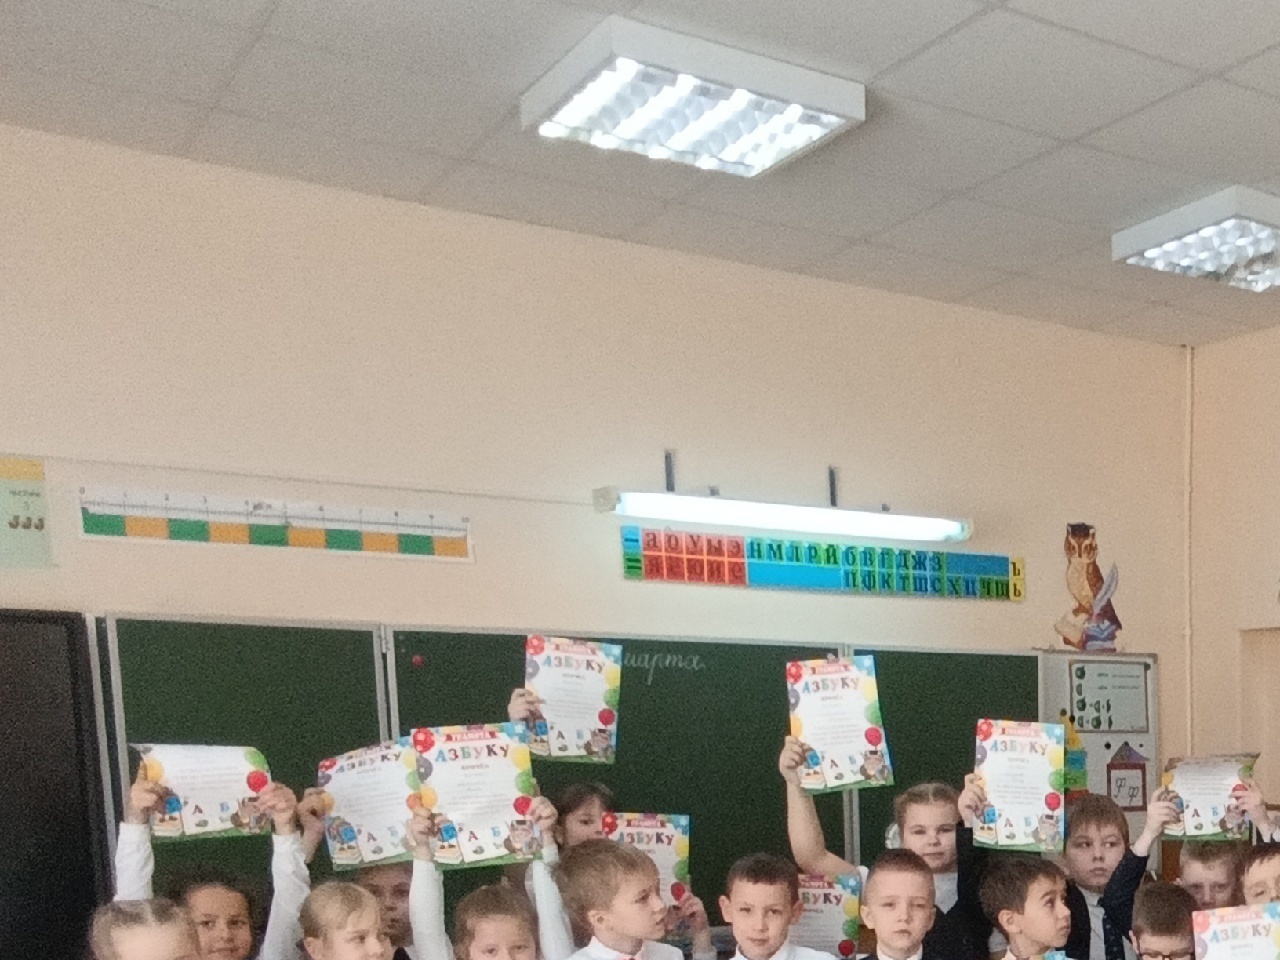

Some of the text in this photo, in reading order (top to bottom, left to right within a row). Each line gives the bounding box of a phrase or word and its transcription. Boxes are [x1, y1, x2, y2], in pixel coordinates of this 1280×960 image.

[543, 655, 606, 674] АЗБУКУ
[802, 677, 860, 694] АЗБУКУ
[434, 744, 509, 763] АЗБУКУ
[989, 740, 1048, 756] АЗБУКУ
[468, 830, 478, 842] А
[1210, 924, 1272, 944] АЗБУКУ
